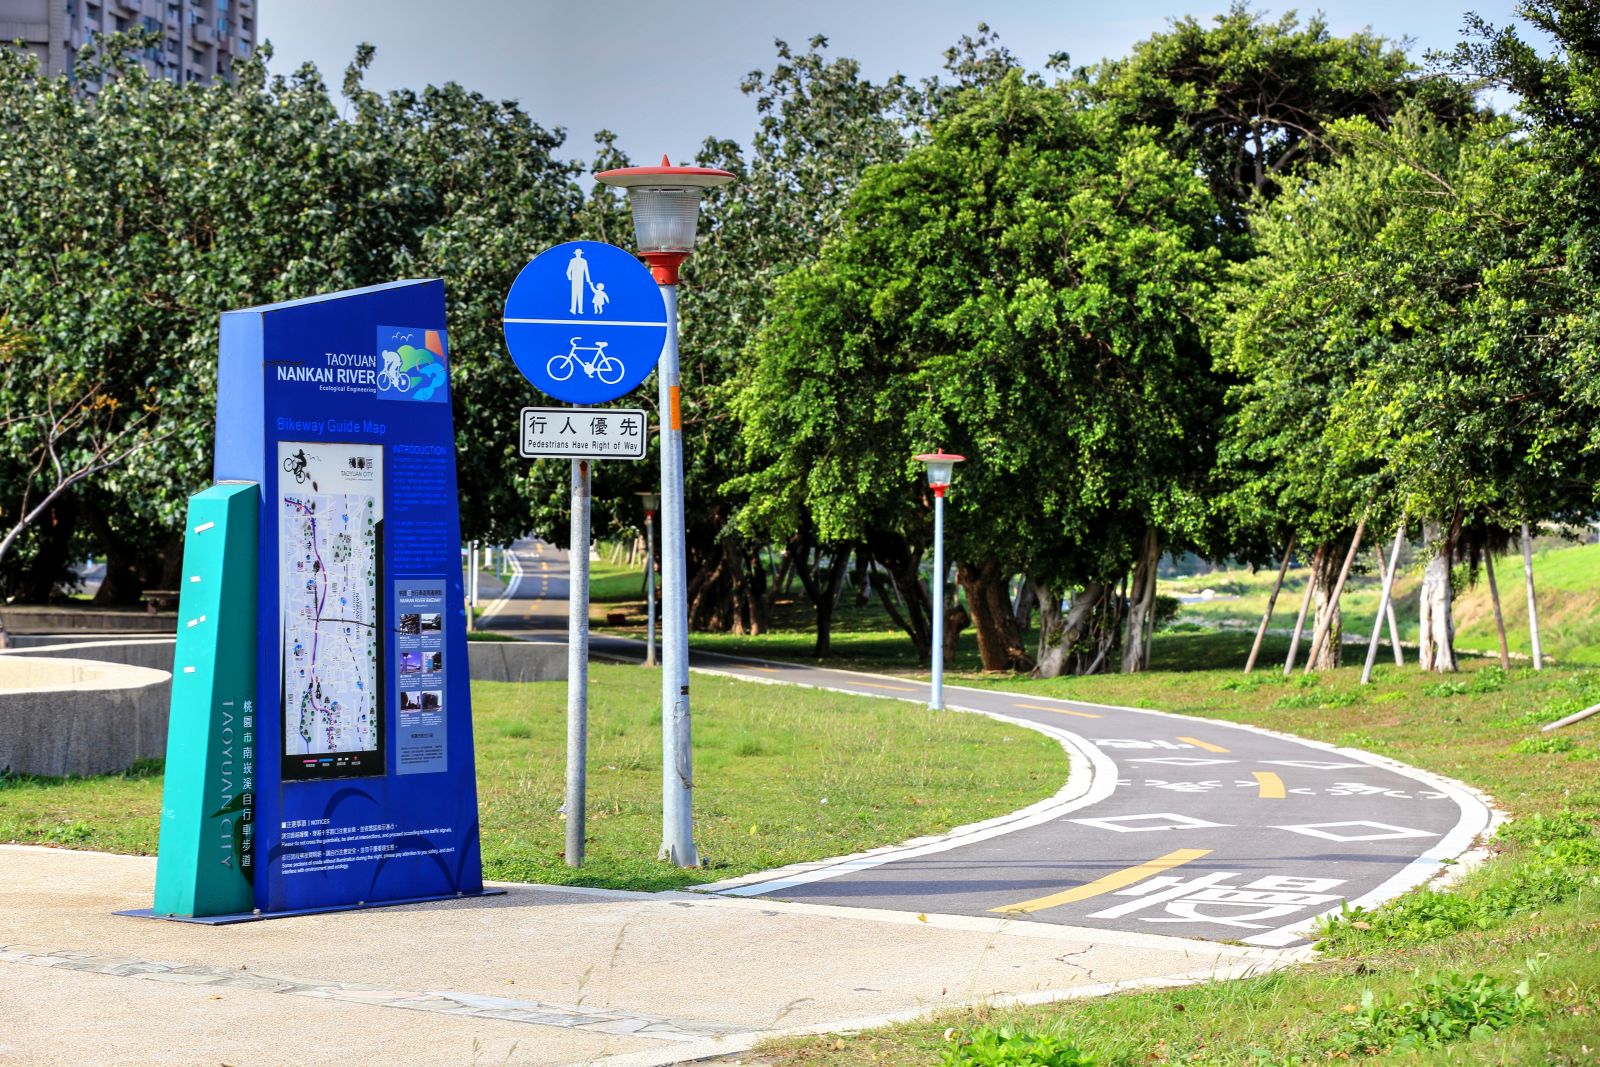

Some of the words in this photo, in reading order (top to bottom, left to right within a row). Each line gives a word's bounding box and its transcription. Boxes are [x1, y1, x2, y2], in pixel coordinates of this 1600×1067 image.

[325, 353, 376, 367] TAOYUAN
[278, 366, 333, 382] NANKAN
[338, 368, 376, 384] RIVER
[278, 417, 324, 434] Bikeway
[328, 419, 360, 432] Guide
[363, 420, 386, 436] Map
[529, 416, 638, 436] 行人優先
[393, 444, 447, 456] INTRODUCTION
[528, 440, 569, 448] Pedestrians
[572, 440, 588, 449] Have
[592, 441, 610, 451] Right
[614, 442, 620, 450] of
[624, 442, 638, 451] Way
[220, 697, 234, 810] TAOYUAN
[220, 818, 233, 870] CITY
[1085, 872, 1350, 928] 慢
